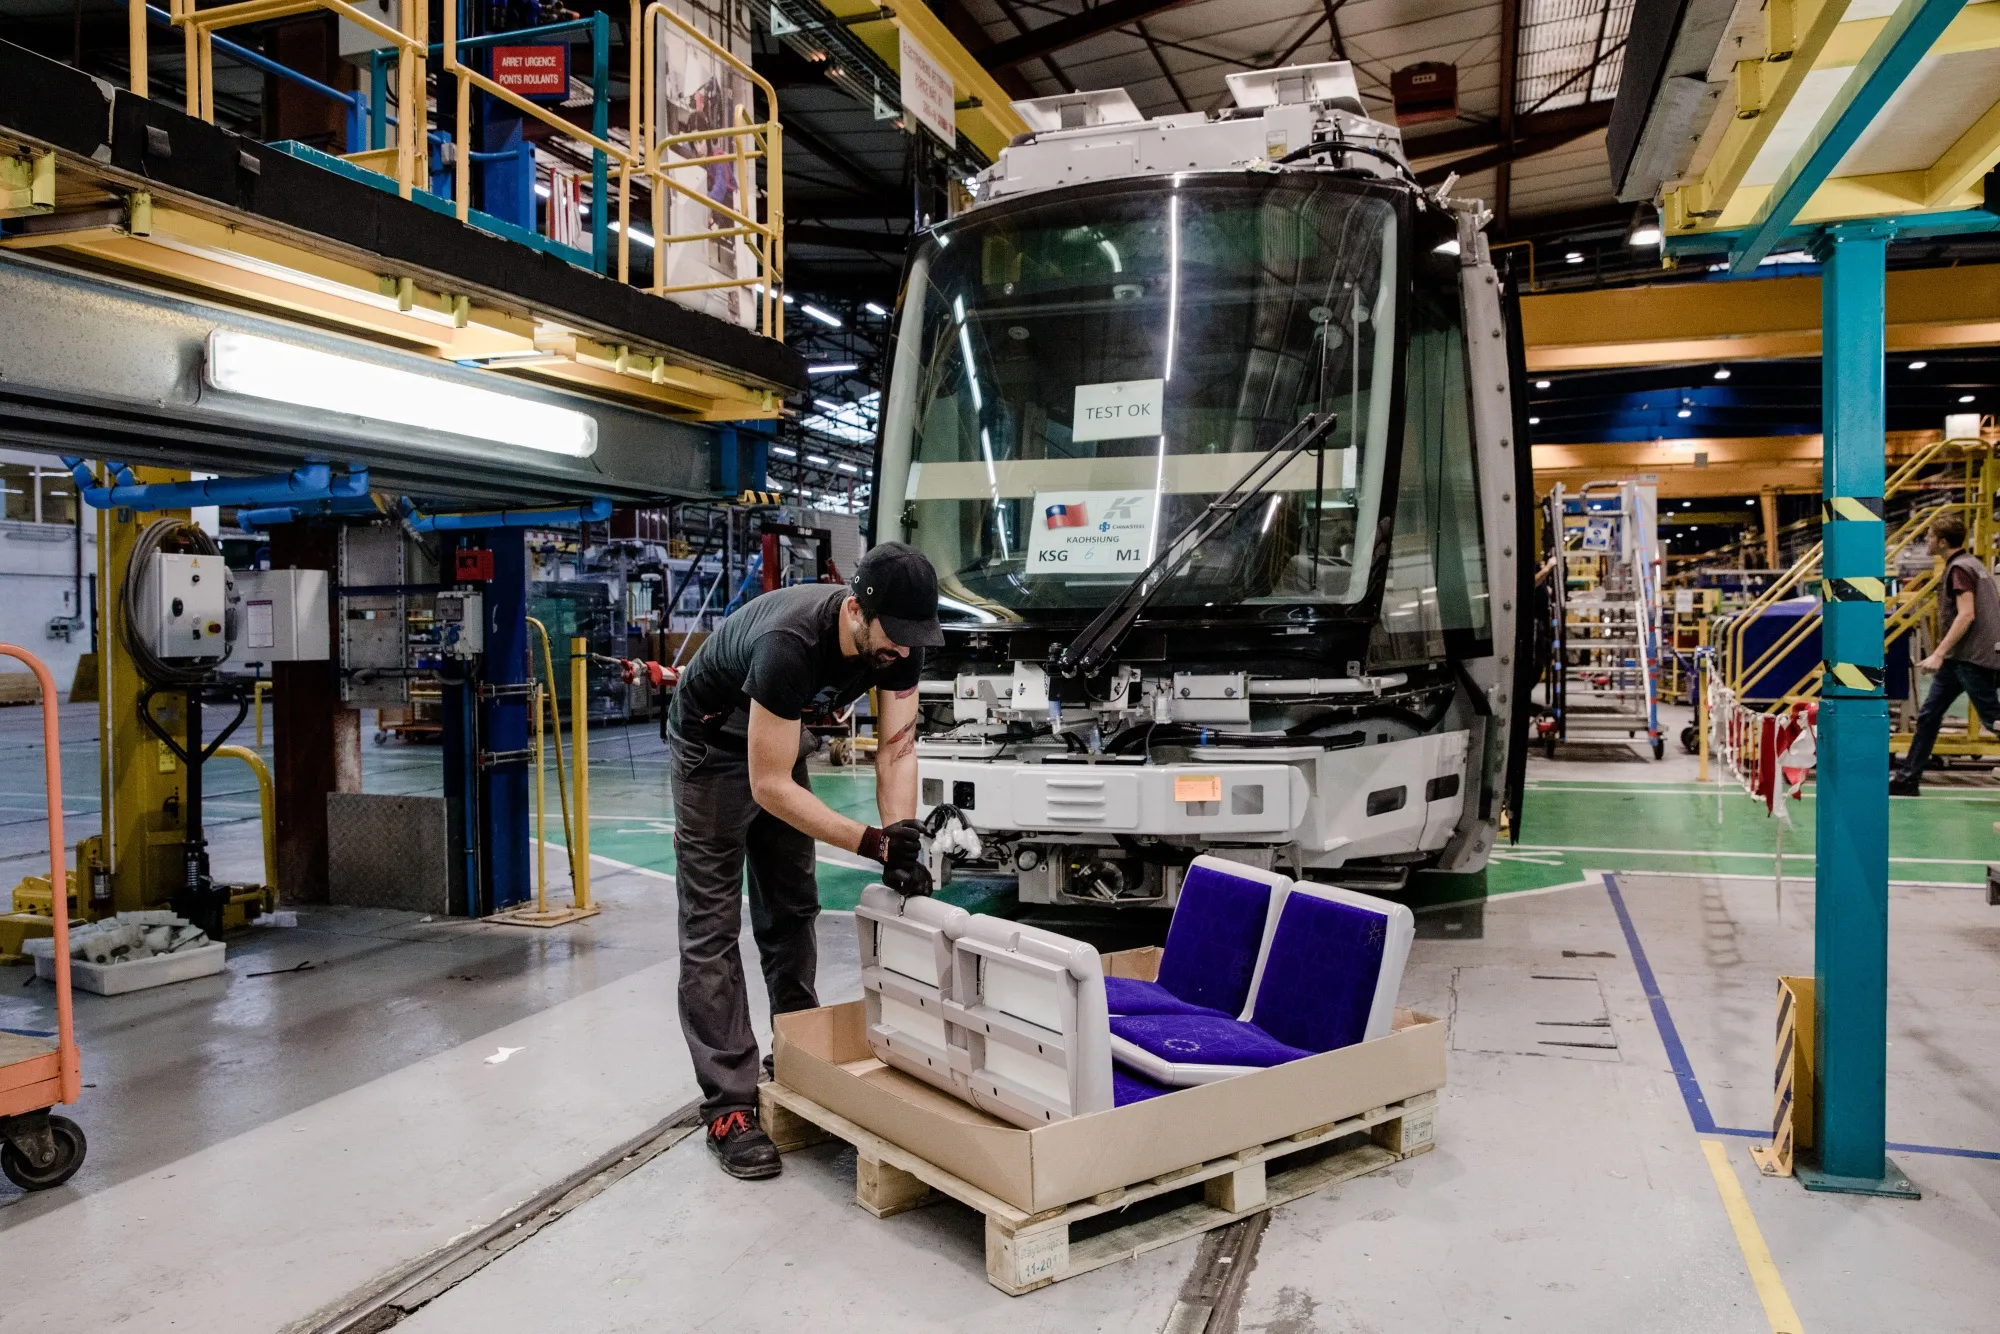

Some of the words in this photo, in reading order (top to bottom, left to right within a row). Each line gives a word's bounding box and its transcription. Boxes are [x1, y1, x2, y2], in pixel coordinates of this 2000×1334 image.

[502, 56, 523, 67] ARRET
[524, 56, 556, 67] URGENCE
[500, 74, 522, 85] PONTS
[523, 74, 559, 85] ROULANTS
[1086, 405, 1123, 420] TEST
[1128, 403, 1151, 417] OK
[1066, 536, 1120, 544] KAOHSIUNG
[1039, 550, 1069, 562] KSG
[1084, 545, 1096, 560] 6
[1116, 549, 1141, 562] M1
